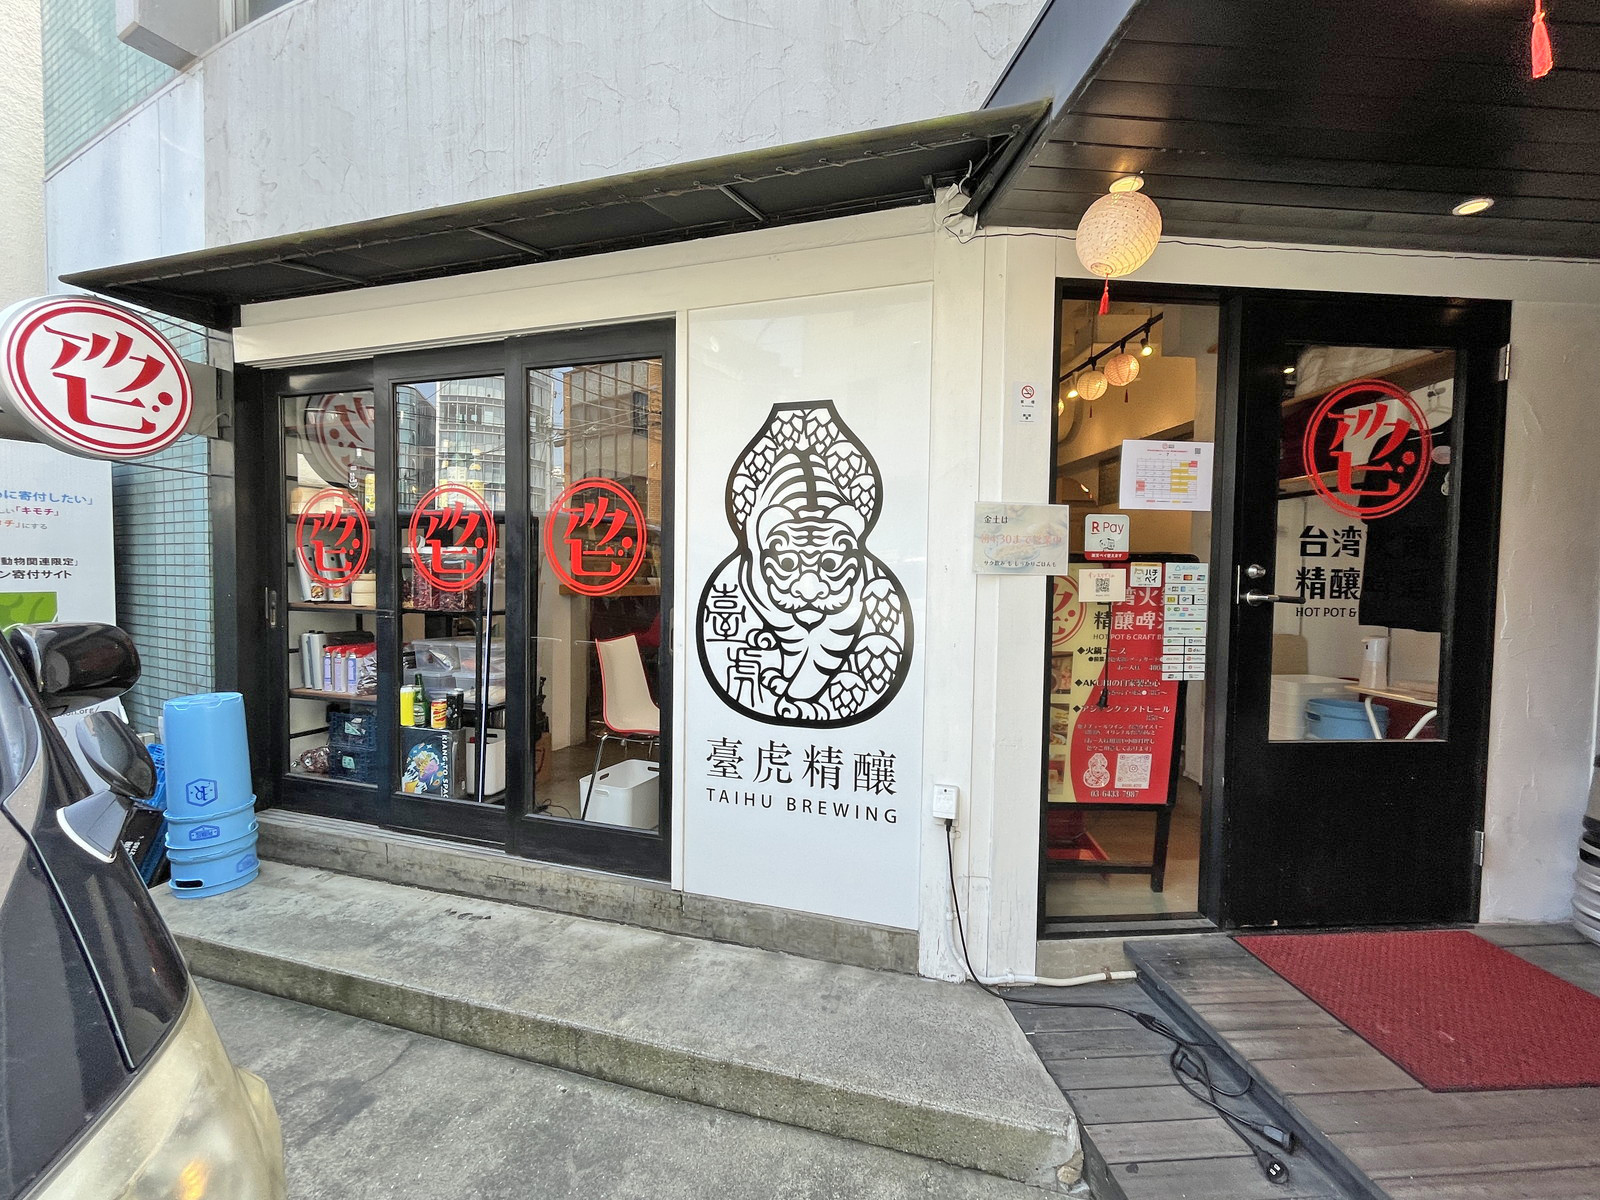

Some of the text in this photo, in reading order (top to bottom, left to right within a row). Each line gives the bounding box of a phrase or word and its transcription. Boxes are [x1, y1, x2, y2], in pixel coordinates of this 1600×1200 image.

[984, 515, 1008, 524] 金土は
[1091, 521, 1125, 535] R Pay
[1299, 525, 1362, 559] 台湾
[1295, 607, 1357, 618] HOT POT &
[442, 764, 449, 776] TO
[705, 736, 898, 797] 臺虎精釀
[706, 787, 898, 824] TAIHU BREWING
